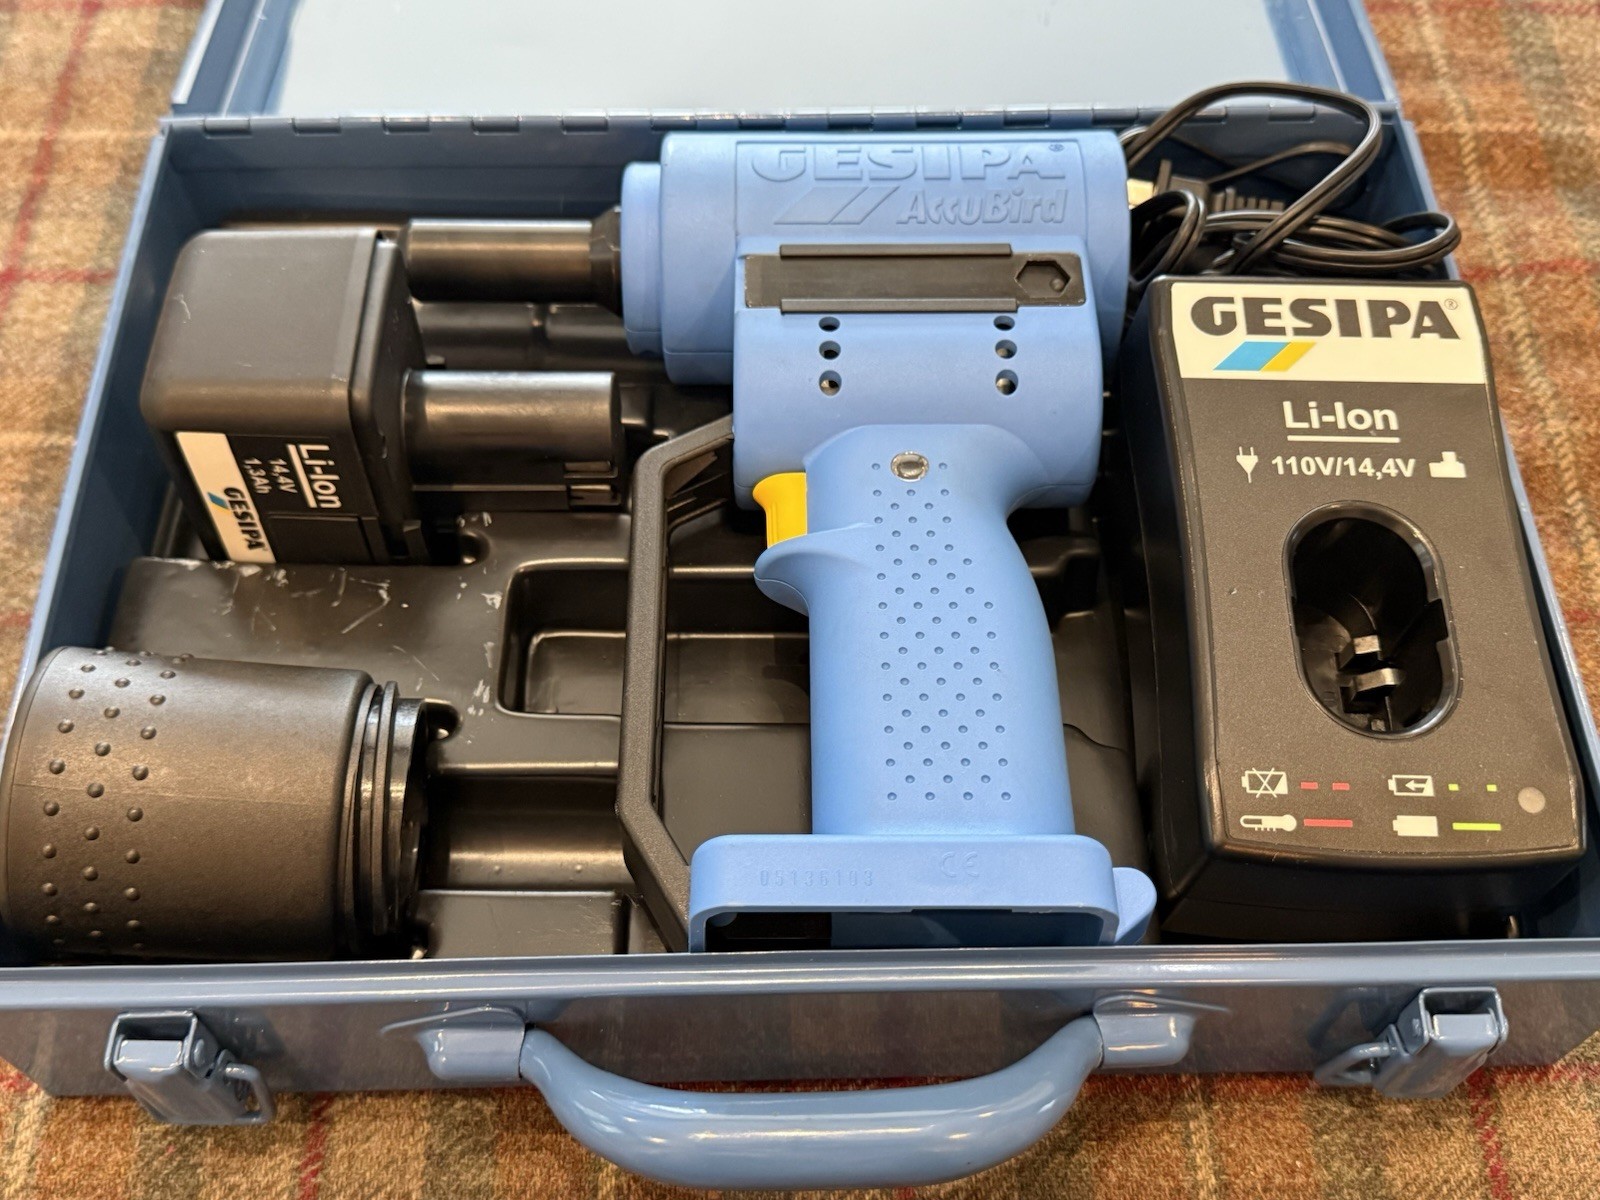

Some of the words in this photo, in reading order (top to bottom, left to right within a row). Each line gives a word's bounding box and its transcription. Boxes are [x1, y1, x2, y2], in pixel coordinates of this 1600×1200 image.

[896, 184, 1069, 226] AccuBird
[1282, 400, 1399, 431] Li-Ion
[268, 457, 299, 494] 14,4V
[298, 444, 343, 510] Li-Ion
[1271, 455, 1416, 481] 110V/14,4V
